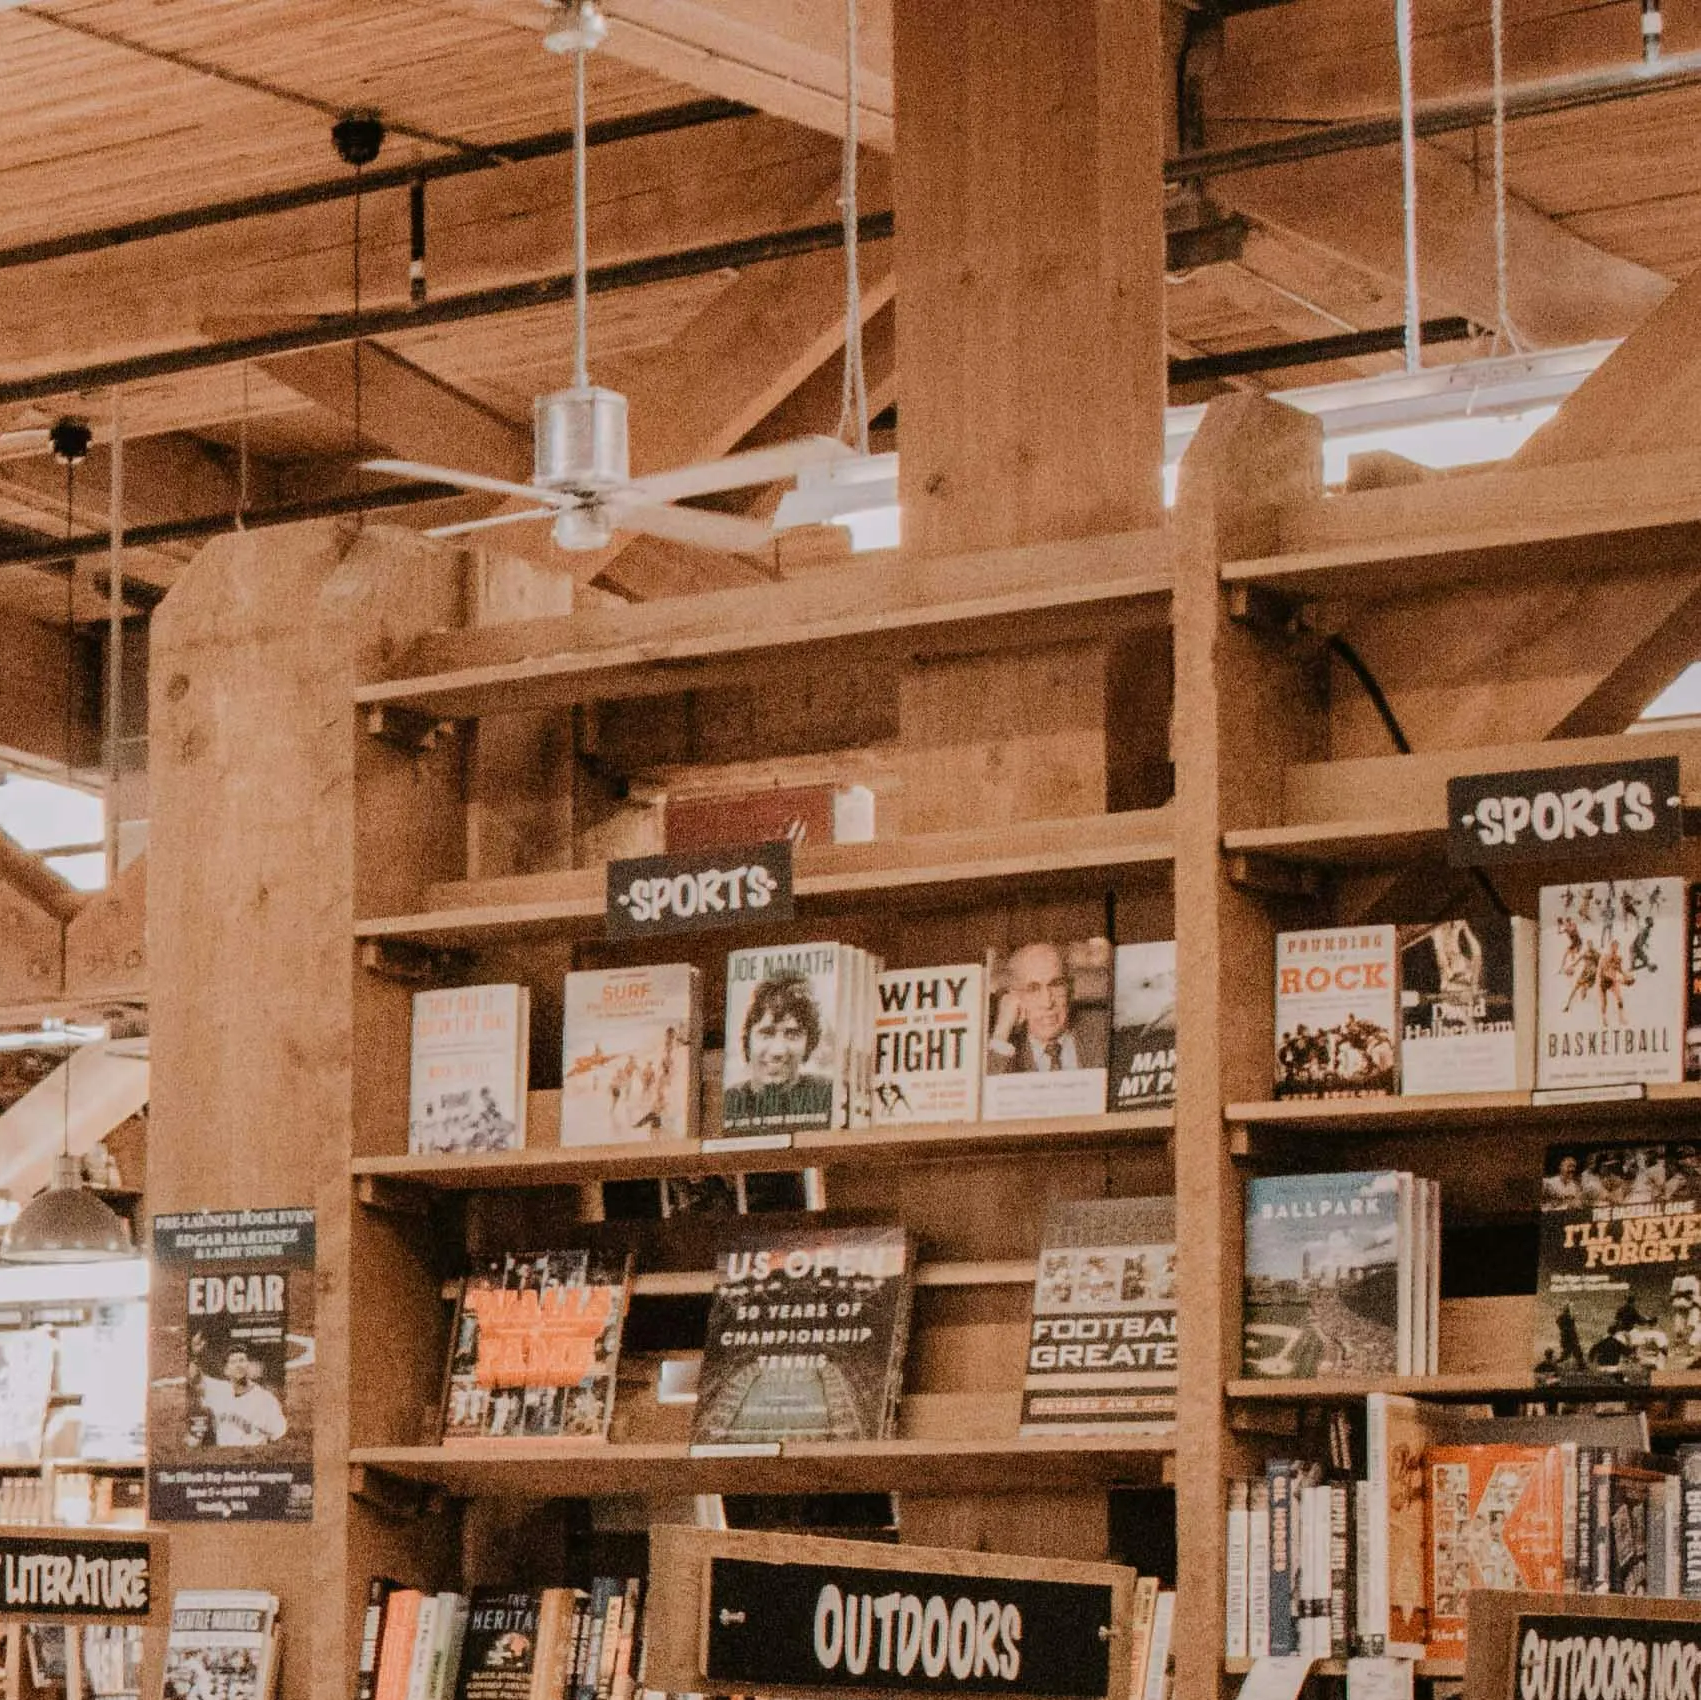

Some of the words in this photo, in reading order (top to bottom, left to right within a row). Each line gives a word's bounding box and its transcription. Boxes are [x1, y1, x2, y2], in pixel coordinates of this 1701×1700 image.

[1474, 781, 1654, 845] SPORTS
[630, 865, 772, 923] SPORTS
[1286, 934, 1383, 954] POUNDING
[763, 949, 834, 977] NAMATH
[602, 983, 652, 1001] SURF
[1279, 963, 1389, 994] ROCK
[877, 978, 969, 1011] WHY
[874, 1027, 968, 1073] FIGHT
[1548, 1028, 1671, 1057] BASKETBALL
[1262, 1200, 1380, 1220] BALLPARK
[727, 1251, 771, 1281] US
[1585, 1240, 1690, 1268] FORGET
[188, 1274, 285, 1316] EDGAR
[737, 1305, 760, 1321] 50
[768, 1302, 828, 1319] YEARS
[836, 1301, 862, 1317] OF
[720, 1327, 873, 1346] CHAMPIONSHIP
[1033, 1317, 1177, 1340] FOOTBA
[757, 1354, 828, 1369] TENNIS
[3, 1552, 148, 1608] LITERATURE
[473, 1608, 540, 1631] HERITA
[815, 1583, 1022, 1683] OUTDOORS
